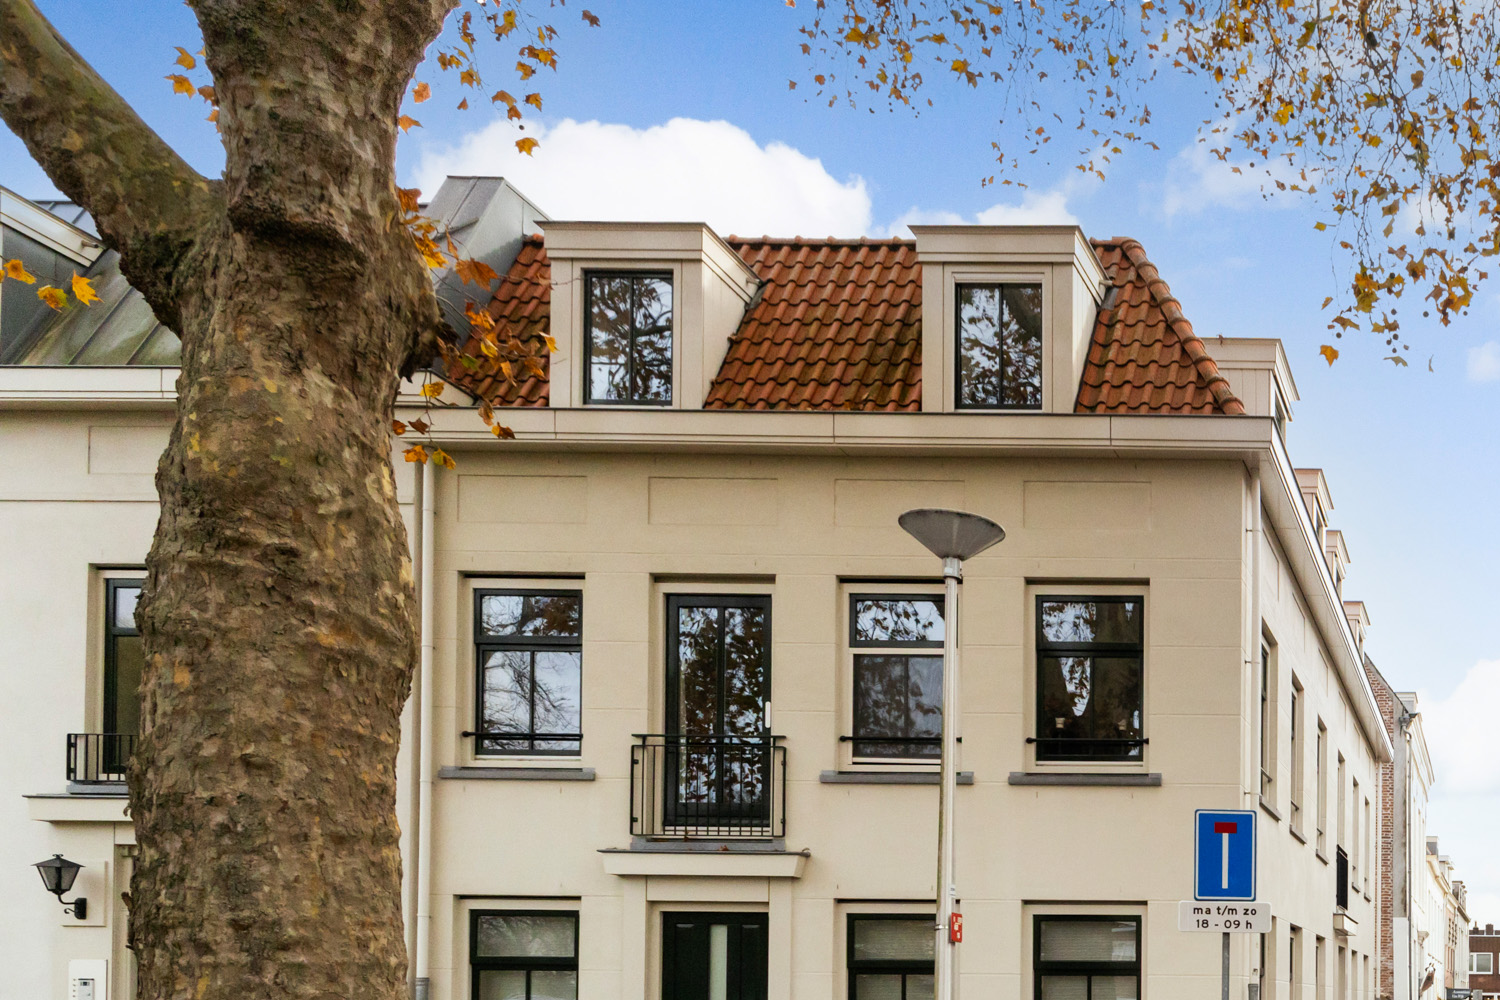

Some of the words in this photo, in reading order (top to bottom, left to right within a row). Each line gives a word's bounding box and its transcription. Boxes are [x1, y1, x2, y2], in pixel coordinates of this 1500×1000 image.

[1193, 907, 1211, 915] ma
[1216, 905, 1238, 916] t/m
[1243, 908, 1257, 916] zo
[1196, 919, 1209, 928] 18
[1224, 919, 1241, 929] 09
[1245, 920, 1252, 929] h
